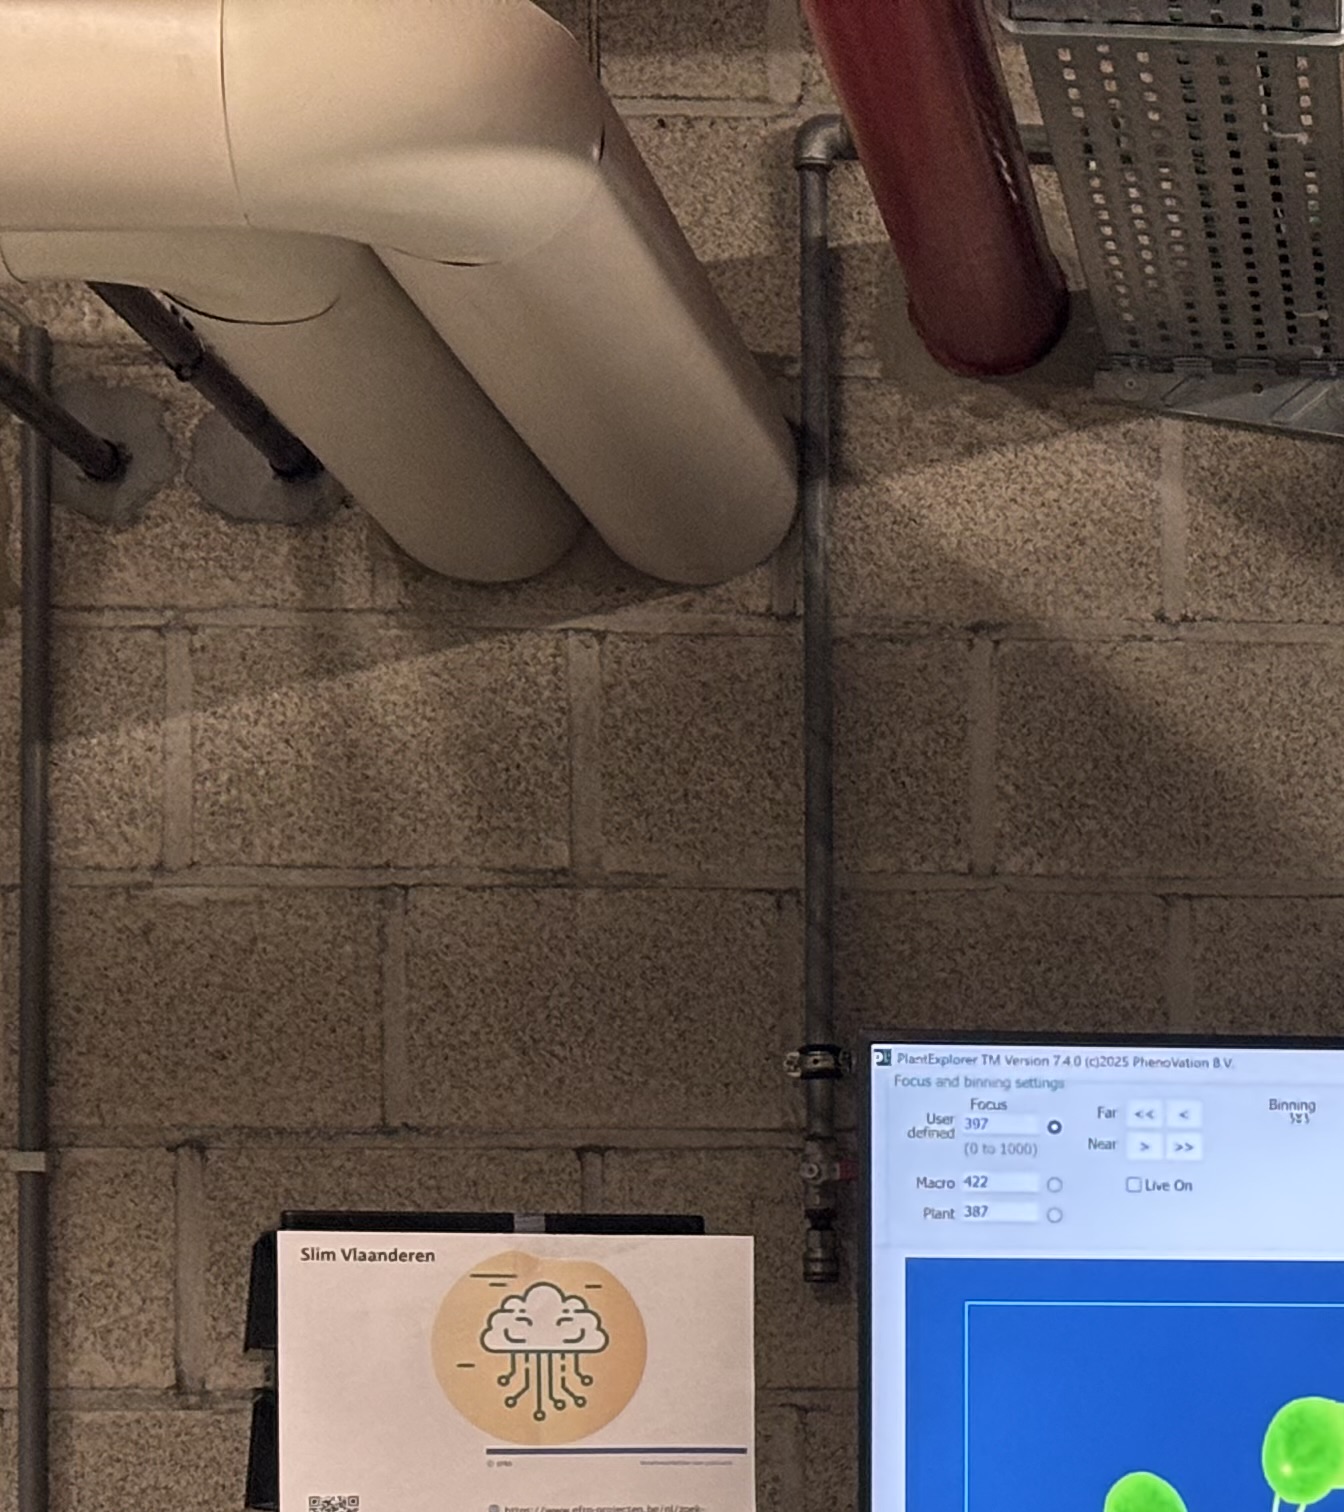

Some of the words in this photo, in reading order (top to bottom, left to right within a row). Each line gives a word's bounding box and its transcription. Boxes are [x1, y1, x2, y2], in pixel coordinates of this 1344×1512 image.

[897, 1054, 978, 1067] PlantExplorer
[981, 1055, 1001, 1066] TM
[1004, 1055, 1050, 1067] Version
[1132, 1057, 1209, 1068] PhenoVation
[895, 1076, 933, 1089] Focus
[936, 1076, 959, 1089] and
[964, 1076, 1011, 1091] binning
[1015, 1076, 1065, 1091] settings
[971, 1098, 1008, 1111] Focus
[1269, 1099, 1316, 1114] Binning
[926, 1113, 954, 1126] User
[1098, 1107, 1117, 1119] Far
[964, 1118, 989, 1130] 397
[907, 1127, 955, 1140] defined
[1088, 1138, 1117, 1150] Near
[917, 1177, 955, 1189] Macro
[963, 1176, 988, 1189] 422
[1146, 1179, 1171, 1192] Live
[1174, 1180, 1193, 1192] On
[923, 1207, 955, 1220] Plant
[964, 1206, 988, 1218] 387
[300, 1248, 336, 1262] Slim
[341, 1248, 435, 1263] Vlaanderen
